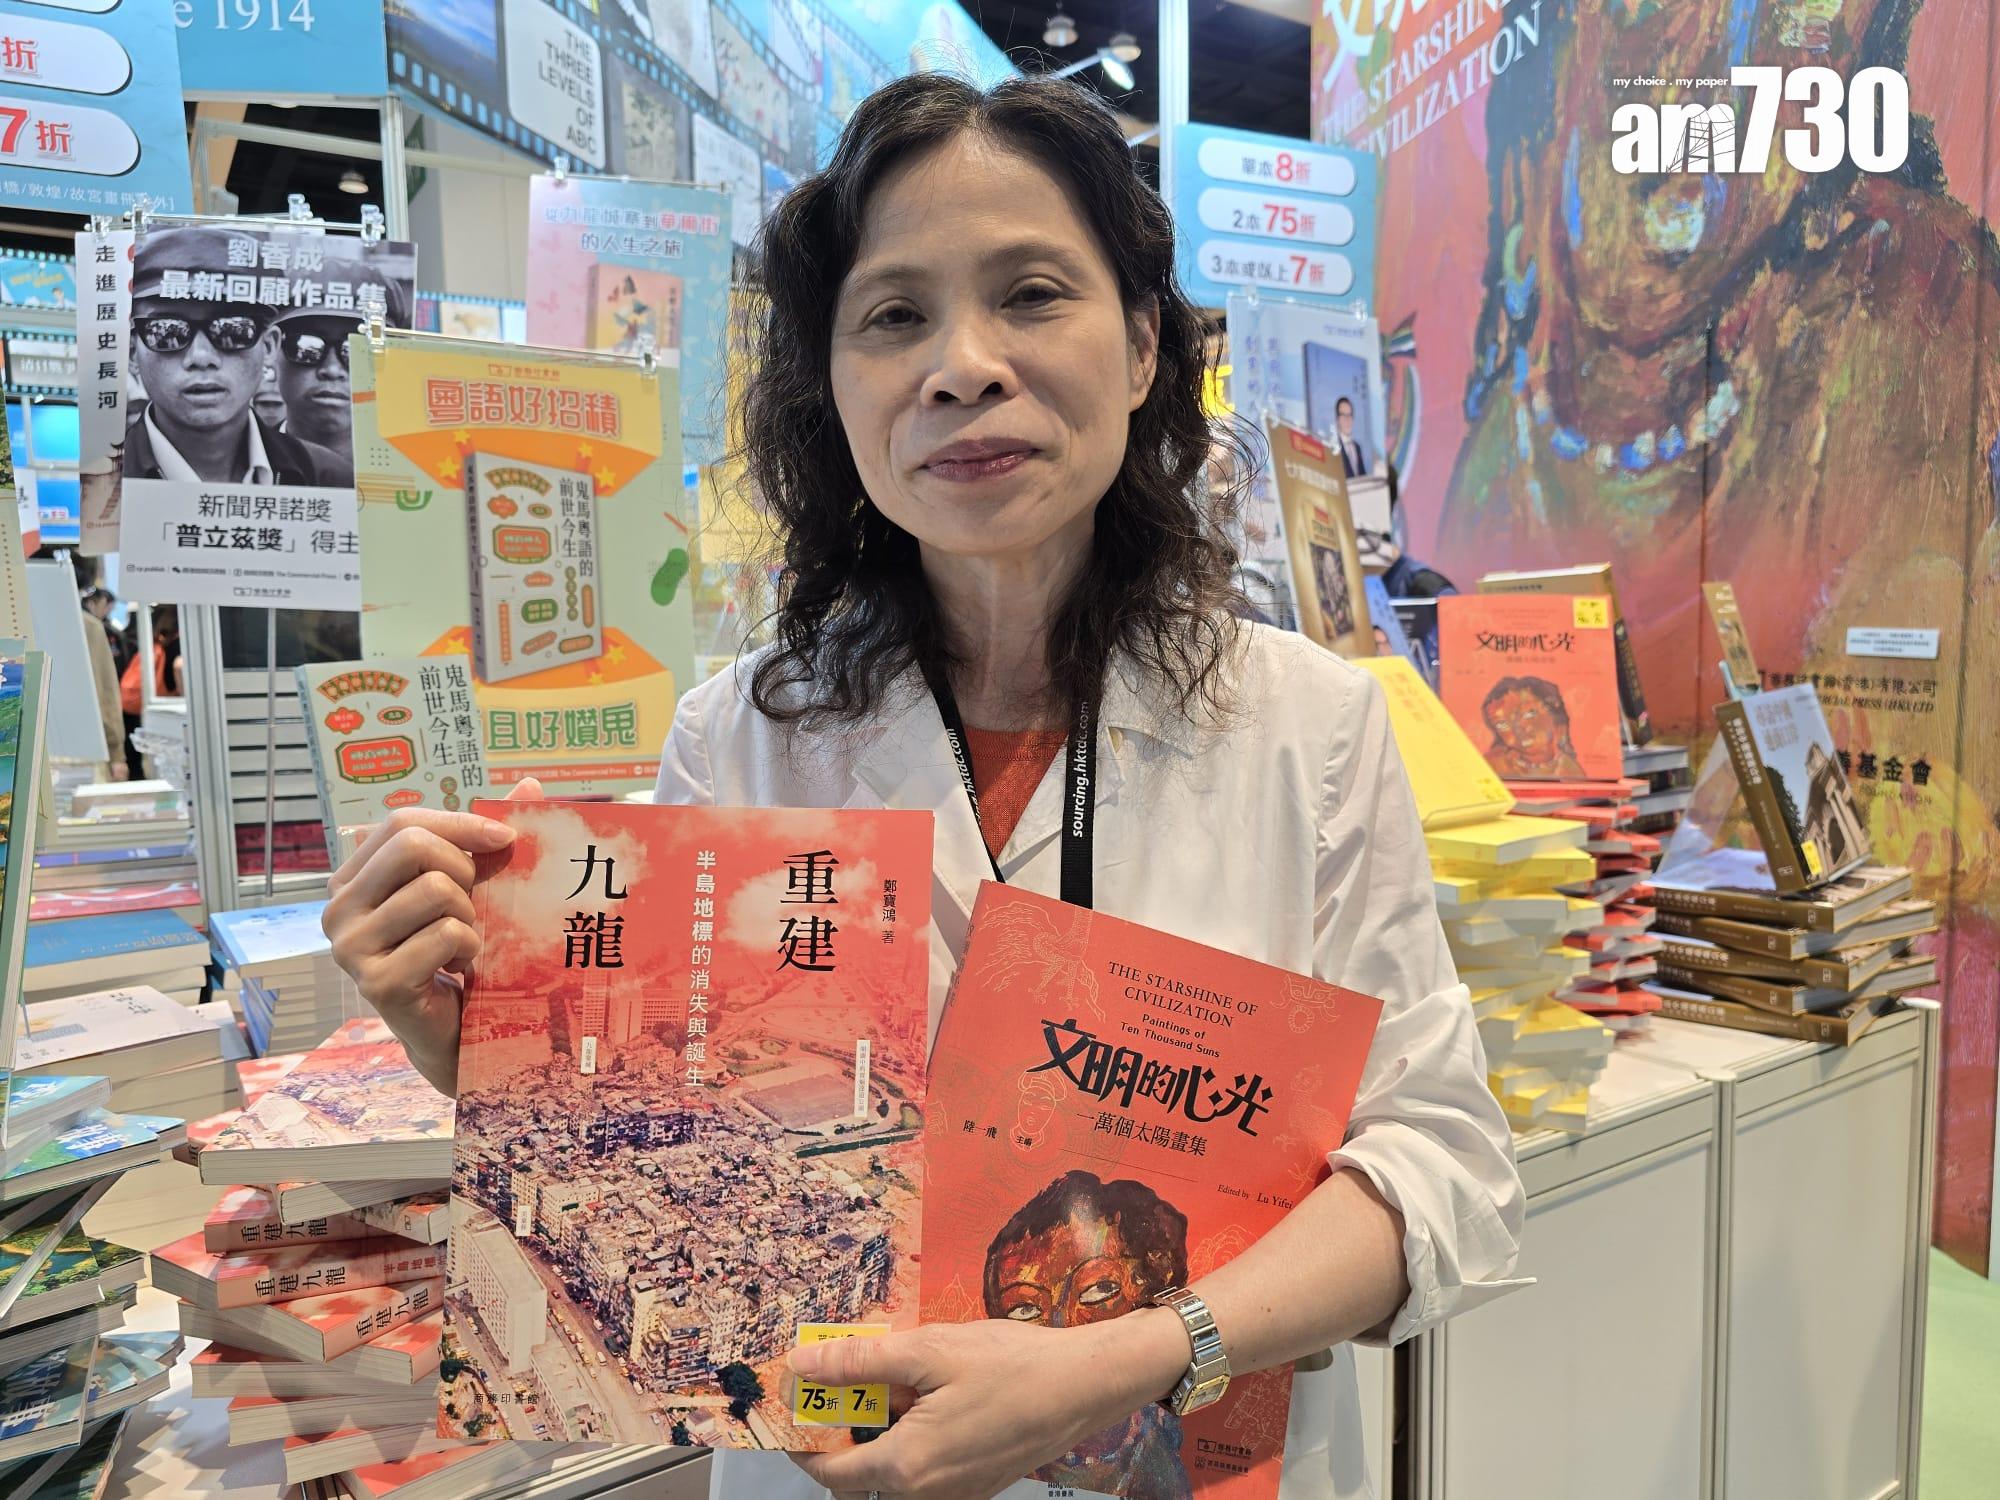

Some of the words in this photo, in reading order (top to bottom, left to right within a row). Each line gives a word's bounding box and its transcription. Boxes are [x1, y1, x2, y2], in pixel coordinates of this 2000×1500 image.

[216, 0, 315, 31] 1914
[544, 39, 593, 81] THREE
[566, 29, 592, 54] THE
[538, 60, 594, 108] LEVELS
[577, 107, 594, 127] OF
[565, 129, 595, 155] ABC
[1233, 204, 1315, 236] 2本75折
[227, 239, 325, 271] 劉香成
[581, 232, 682, 258] 的人生之旅
[159, 270, 387, 309] 最新回顧作品集
[1211, 255, 1325, 286] 3本或以上7折
[95, 245, 118, 410] 走進歷史長河
[426, 379, 621, 437] 粵語好招積
[199, 494, 332, 523] 新聞界諾獎
[559, 477, 578, 558] 前世今生
[576, 480, 593, 577] 鬼馬粵語的
[418, 666, 458, 768] 前世今生
[444, 665, 486, 789] 鬼馬粵語的
[1072, 701, 1089, 838] sourcing.hktdc.com
[564, 844, 628, 969] 九龍
[776, 849, 840, 972] 重建
[882, 879, 897, 923] 鄭寶鴻
[881, 930, 895, 944] 著
[684, 850, 717, 1087] 半島地標的消失與誕生
[1107, 961, 1141, 983] THE
[1144, 972, 1233, 1010] STARSHINE
[1236, 1000, 1259, 1017] OF
[1123, 986, 1234, 1028] CIVILIZATION
[1120, 1021, 1138, 1034] Ten
[1143, 1027, 1193, 1051] Thousand
[1196, 1043, 1220, 1058] Suns
[1142, 1013, 1191, 1037] Paintings
[1193, 1029, 1206, 1039] of
[1026, 1018, 1274, 1137] 文明的心光
[963, 1119, 998, 1140] 陸一飛
[1016, 1134, 1032, 1147] 主編
[1075, 1112, 1207, 1157] 一萬個太陽畫集
[1217, 1184, 1239, 1196] Edited
[1241, 1190, 1250, 1201] by
[1256, 1191, 1270, 1204] Lu
[1271, 1196, 1294, 1210] Yifei
[241, 1217, 328, 1243] 重建九龍
[255, 1266, 346, 1298] 重建九龍
[356, 1287, 430, 1339] 重建九龍
[801, 1388, 839, 1410] 75折
[852, 1389, 878, 1411] 7折
